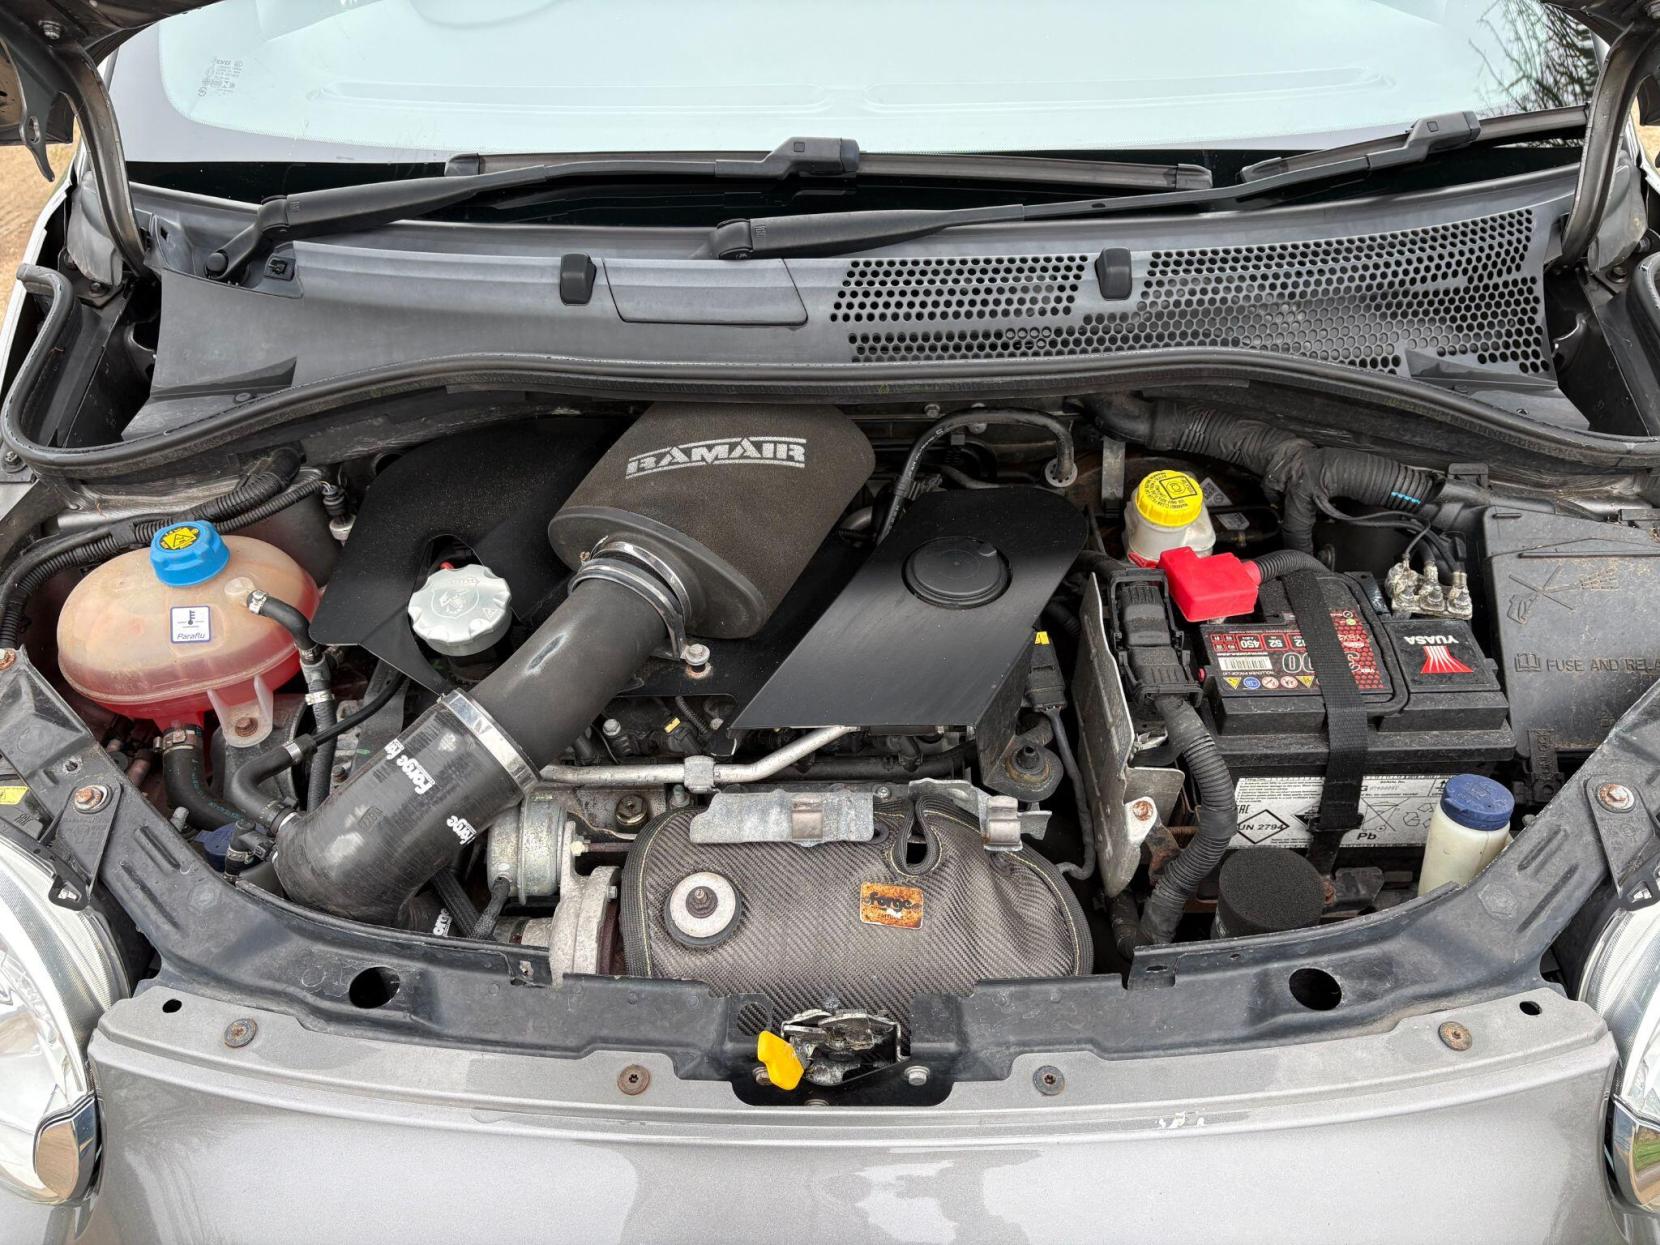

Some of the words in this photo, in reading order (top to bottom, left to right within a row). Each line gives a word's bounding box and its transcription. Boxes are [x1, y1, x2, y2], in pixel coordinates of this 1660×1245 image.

[626, 436, 806, 476] RAMAIR
[1241, 640, 1260, 648] 450
[1268, 640, 1283, 648] 52
[1403, 635, 1459, 645] YUASA
[1546, 658, 1585, 672] FUSE
[1590, 658, 1618, 672] AND
[1257, 823, 1284, 831] 2794
[1357, 832, 1377, 841] Pb
